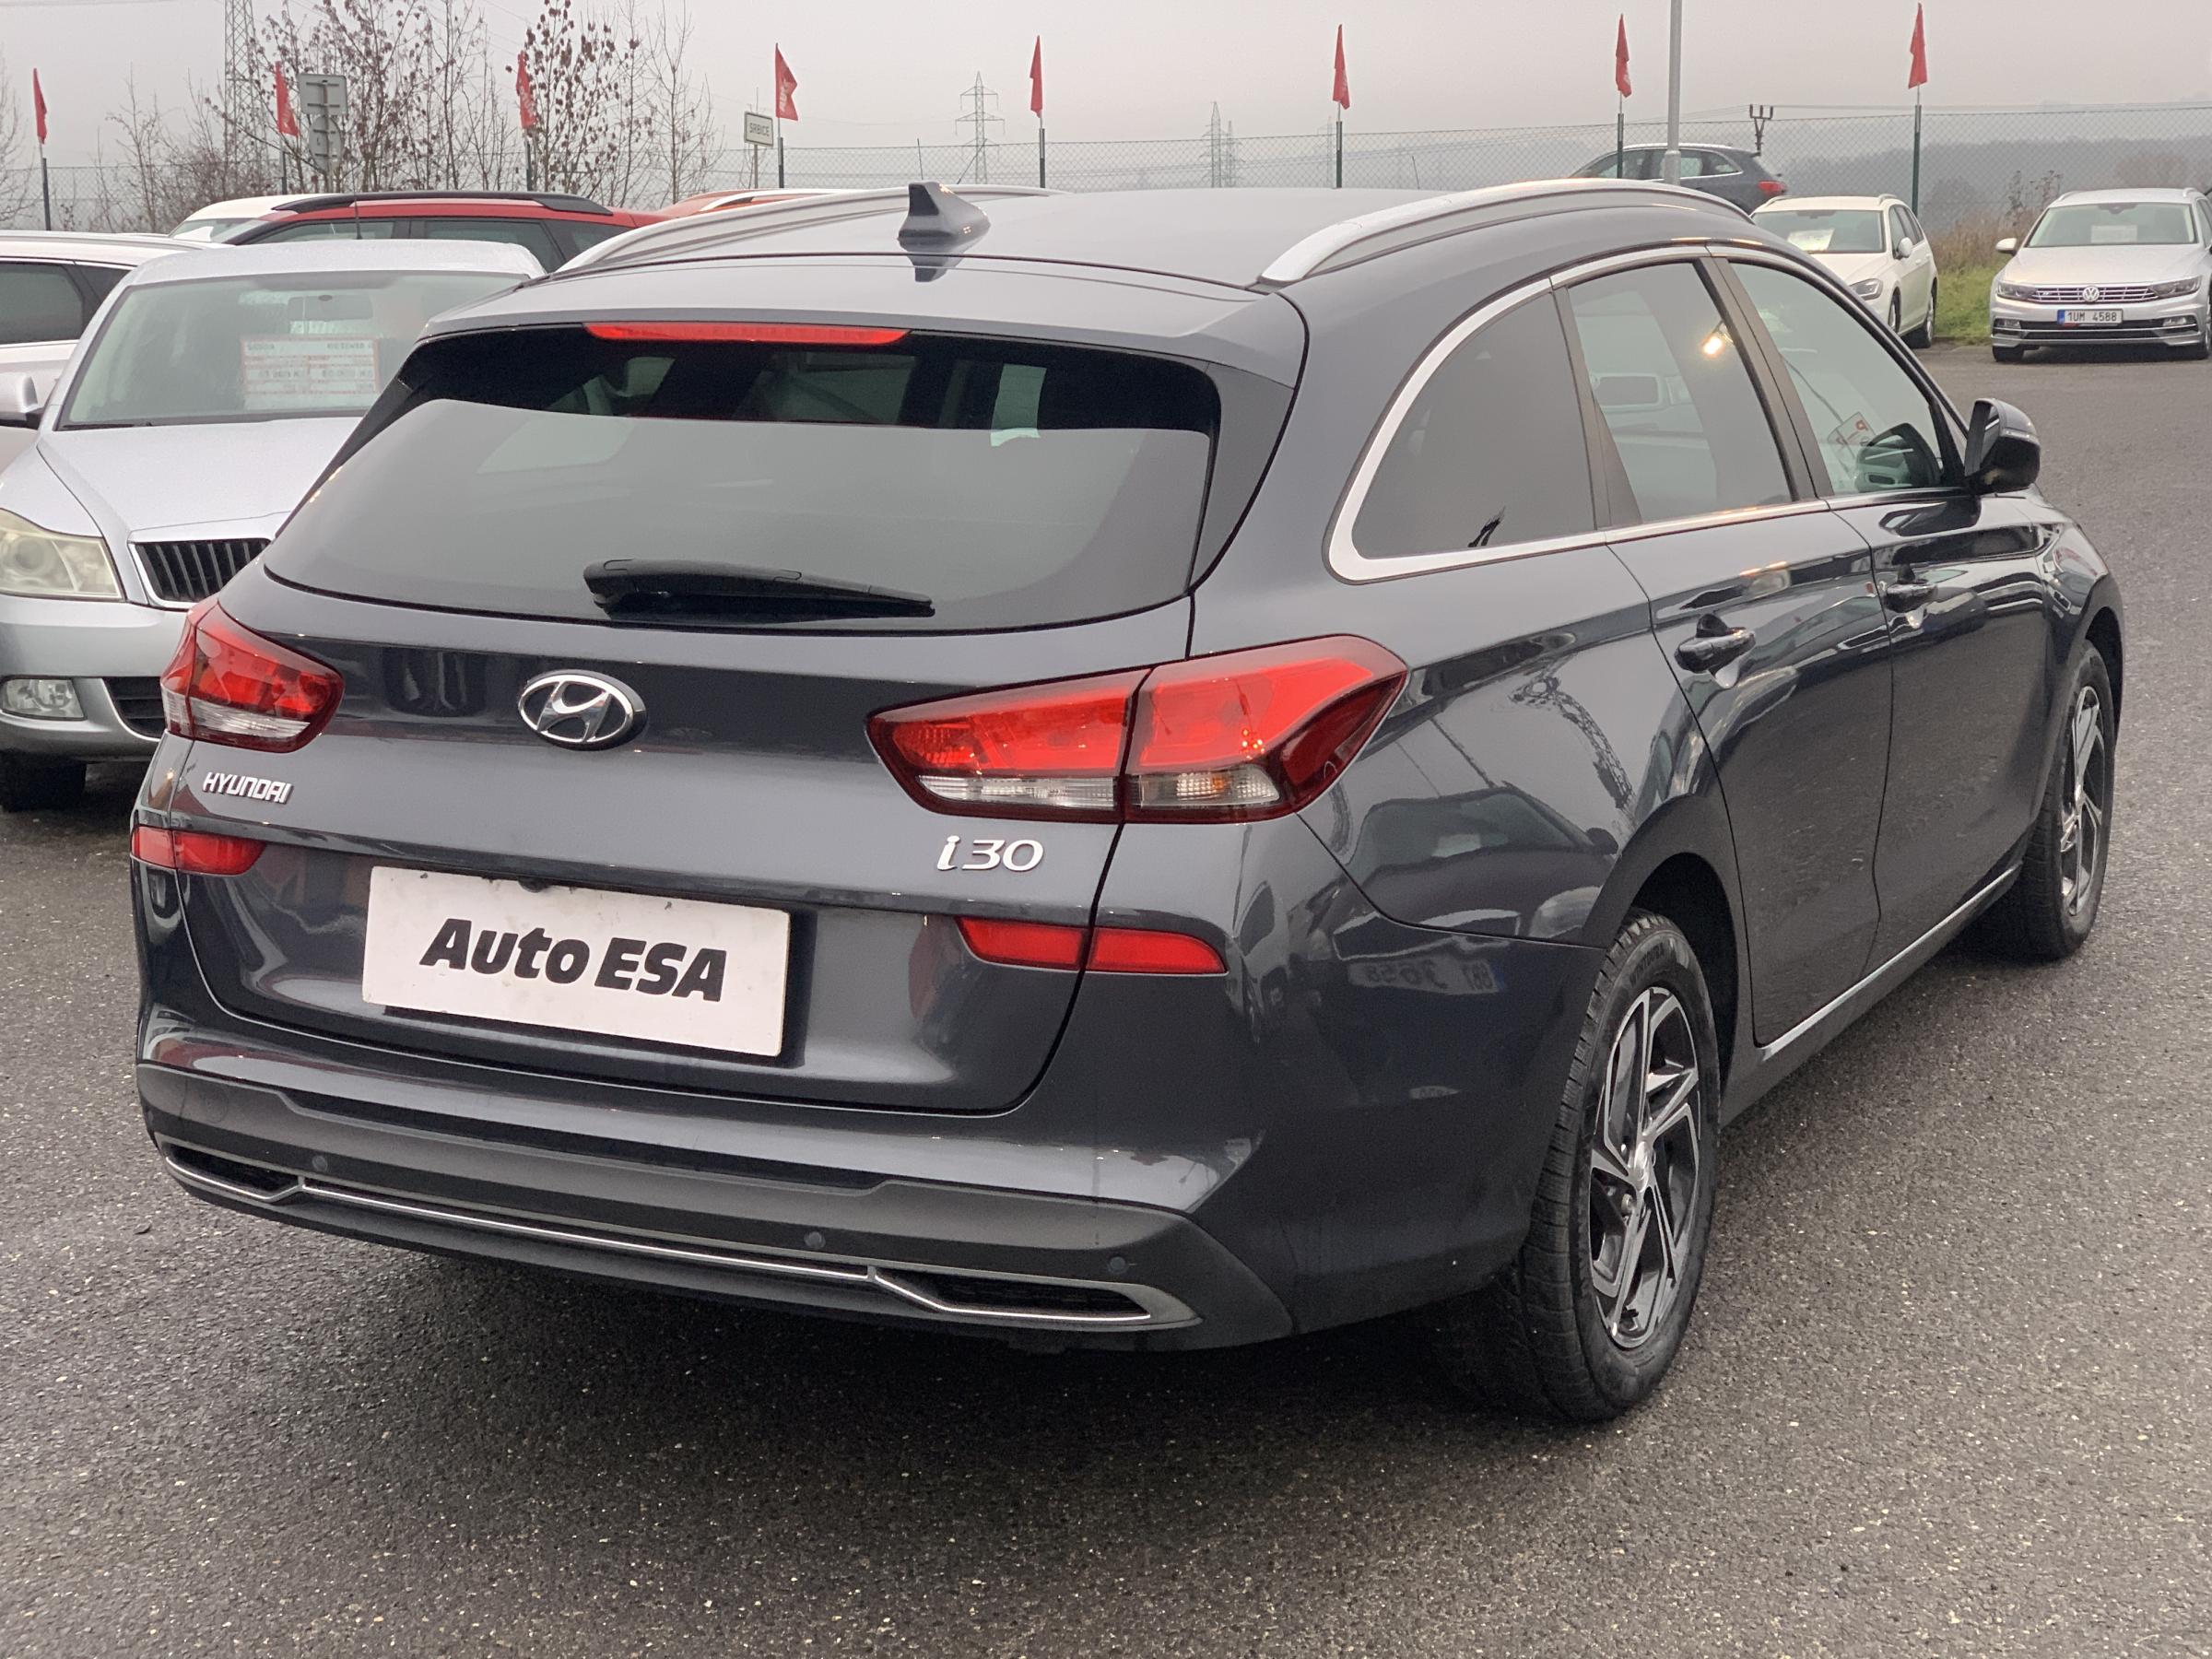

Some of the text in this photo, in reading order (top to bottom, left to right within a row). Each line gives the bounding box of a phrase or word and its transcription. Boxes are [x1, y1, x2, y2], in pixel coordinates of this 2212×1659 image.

[2092, 312, 2117, 322] 4588
[202, 771, 292, 805] HYUNDAI
[936, 835, 1044, 872] i30
[418, 918, 727, 1003] Auto ESA
